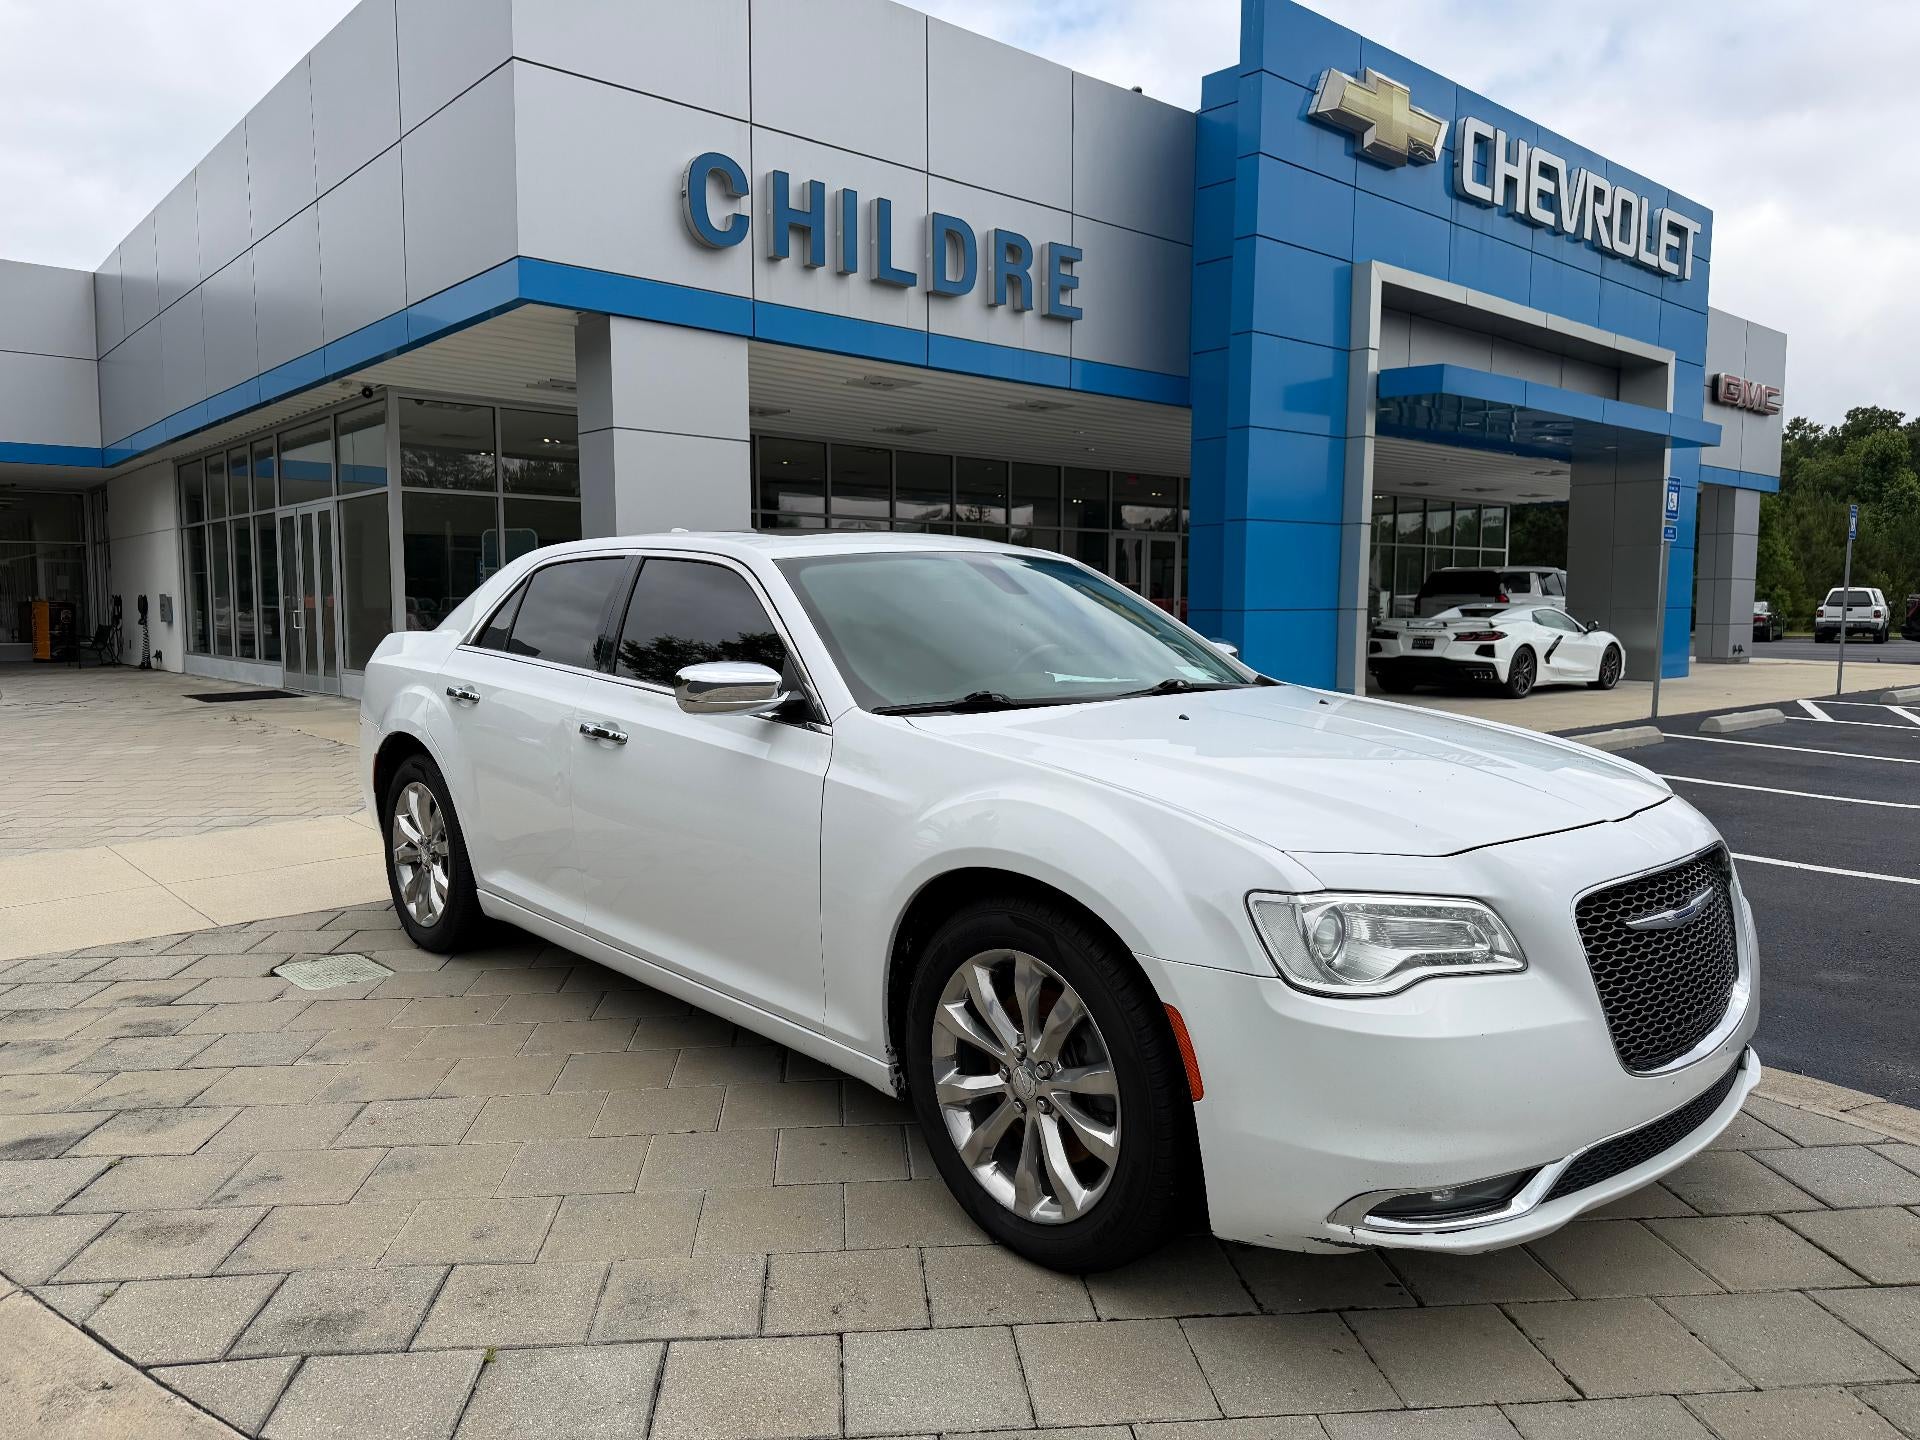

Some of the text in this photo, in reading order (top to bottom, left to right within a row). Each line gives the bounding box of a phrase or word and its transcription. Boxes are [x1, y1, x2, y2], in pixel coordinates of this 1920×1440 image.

[682, 151, 1083, 321] CHILDRE
[1455, 116, 1701, 280] CHEVROLET
[1717, 372, 1781, 415] GMC
